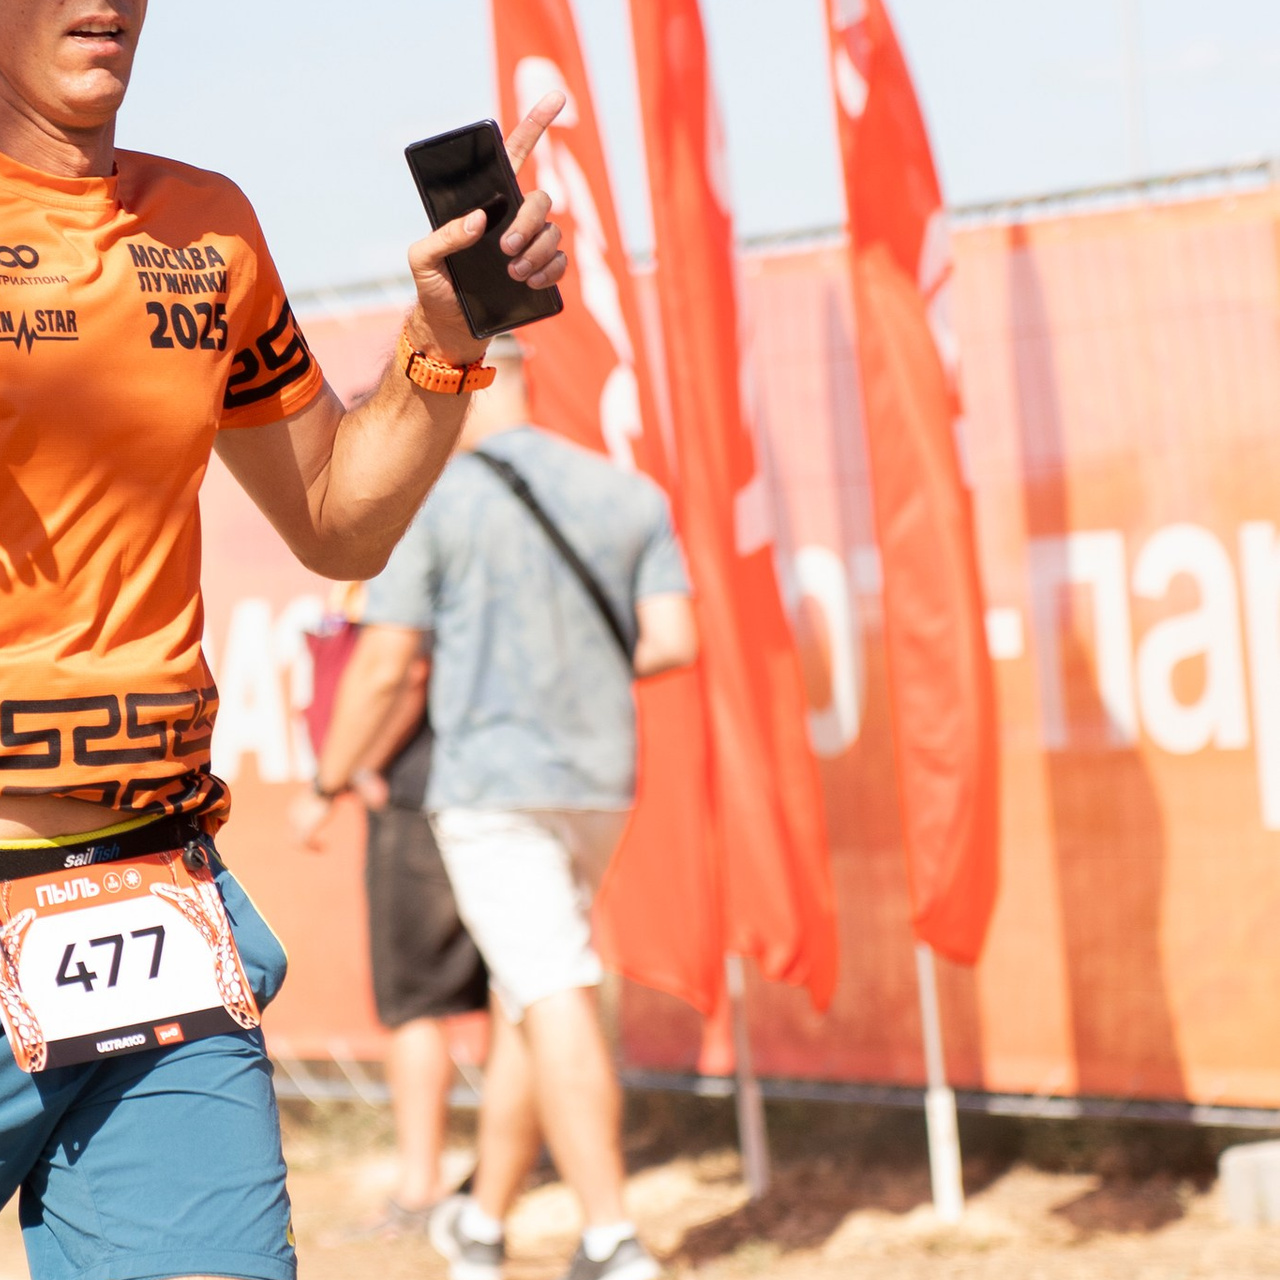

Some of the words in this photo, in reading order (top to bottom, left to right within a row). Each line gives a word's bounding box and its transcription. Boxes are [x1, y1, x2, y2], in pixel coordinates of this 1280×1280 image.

[126, 243, 226, 271] МОСКВА
[137, 270, 228, 295] ЛУЖНИКИ
[34, 309, 78, 333] STAR
[145, 301, 229, 352] 2025
[35, 877, 101, 907] ПЫЛЬ
[55, 924, 166, 993] 477
